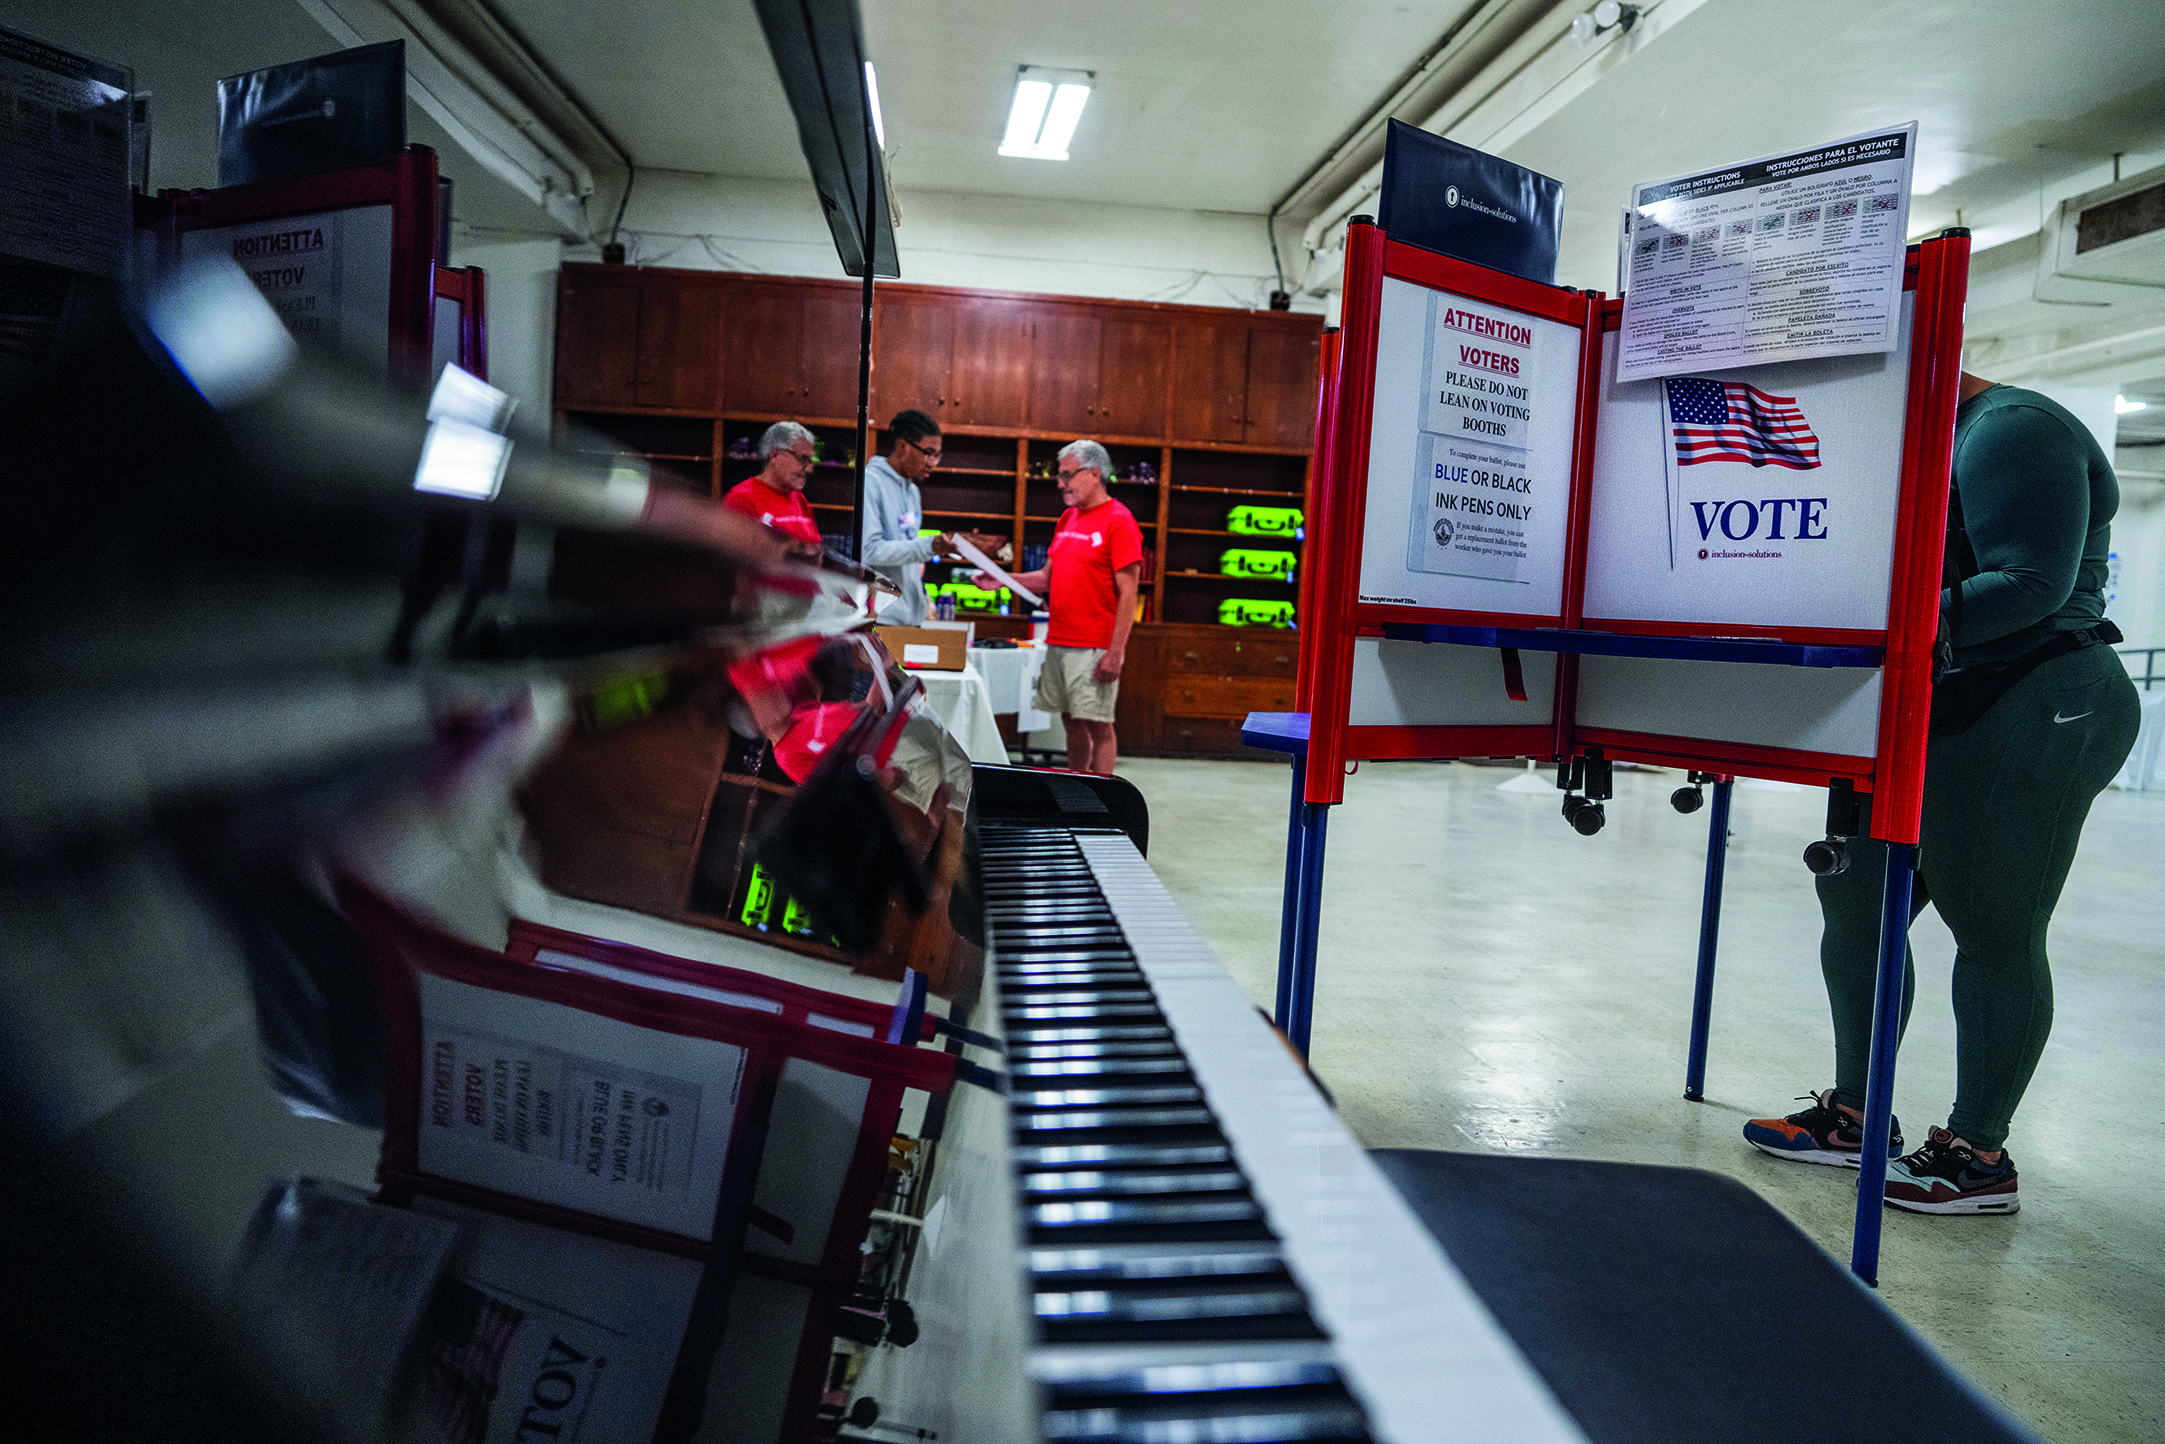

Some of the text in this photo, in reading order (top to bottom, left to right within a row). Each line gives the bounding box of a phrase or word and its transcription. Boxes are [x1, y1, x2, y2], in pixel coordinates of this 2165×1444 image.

[1766, 137, 1899, 171] INSTRUCCIONES PARA EL VOTANTE
[1771, 169, 1786, 177] VOTE
[1800, 162, 1819, 171] AMBOS
[1820, 158, 1839, 167] LADOS
[1856, 148, 1890, 159] NECESARIO
[1670, 171, 1740, 192] VOTER INSTRUCTIONS
[1714, 178, 1744, 188] APPLICABLE
[1759, 181, 1792, 193] PARA VOTAR:
[1781, 188, 1798, 196] UTILICE
[1834, 178, 1847, 186] AZUL
[1760, 199, 1778, 207] RELLENE
[1866, 178, 1892, 188] COLUMNA
[1804, 197, 1827, 205] CLASIFICA
[1461, 195, 1517, 223] inclusion-solutions
[1785, 267, 1814, 276] CANDIDATO
[1827, 261, 1849, 269] ESCRITO
[1669, 286, 1689, 294] WRITE-IN
[1799, 285, 1829, 295] SOBREVOTO
[1672, 305, 1694, 313] OVERVOTE
[1787, 312, 1835, 323] PAPELETA DAÑADA
[1444, 308, 1531, 348] ATTENTION
[1812, 328, 1833, 336] BOLETA
[1459, 344, 1520, 376] VOTERS
[1446, 371, 1528, 401] PLEASE DO NOT
[1440, 391, 1530, 421] LEAN ON VOTING
[1463, 416, 1506, 437] BOOTHS
[1449, 448, 1456, 456] To
[1457, 451, 1478, 460] complete
[1435, 463, 1532, 494] BLUE OR BLACK
[1435, 492, 1532, 520] INK PENS ONLY
[1690, 498, 1827, 541] VOTE
[1462, 523, 1470, 531] you
[1488, 526, 1506, 535] mistake,
[1467, 535, 1494, 543] replacement
[1508, 539, 1519, 547] from
[1711, 549, 1782, 558] inclusion-solutions
